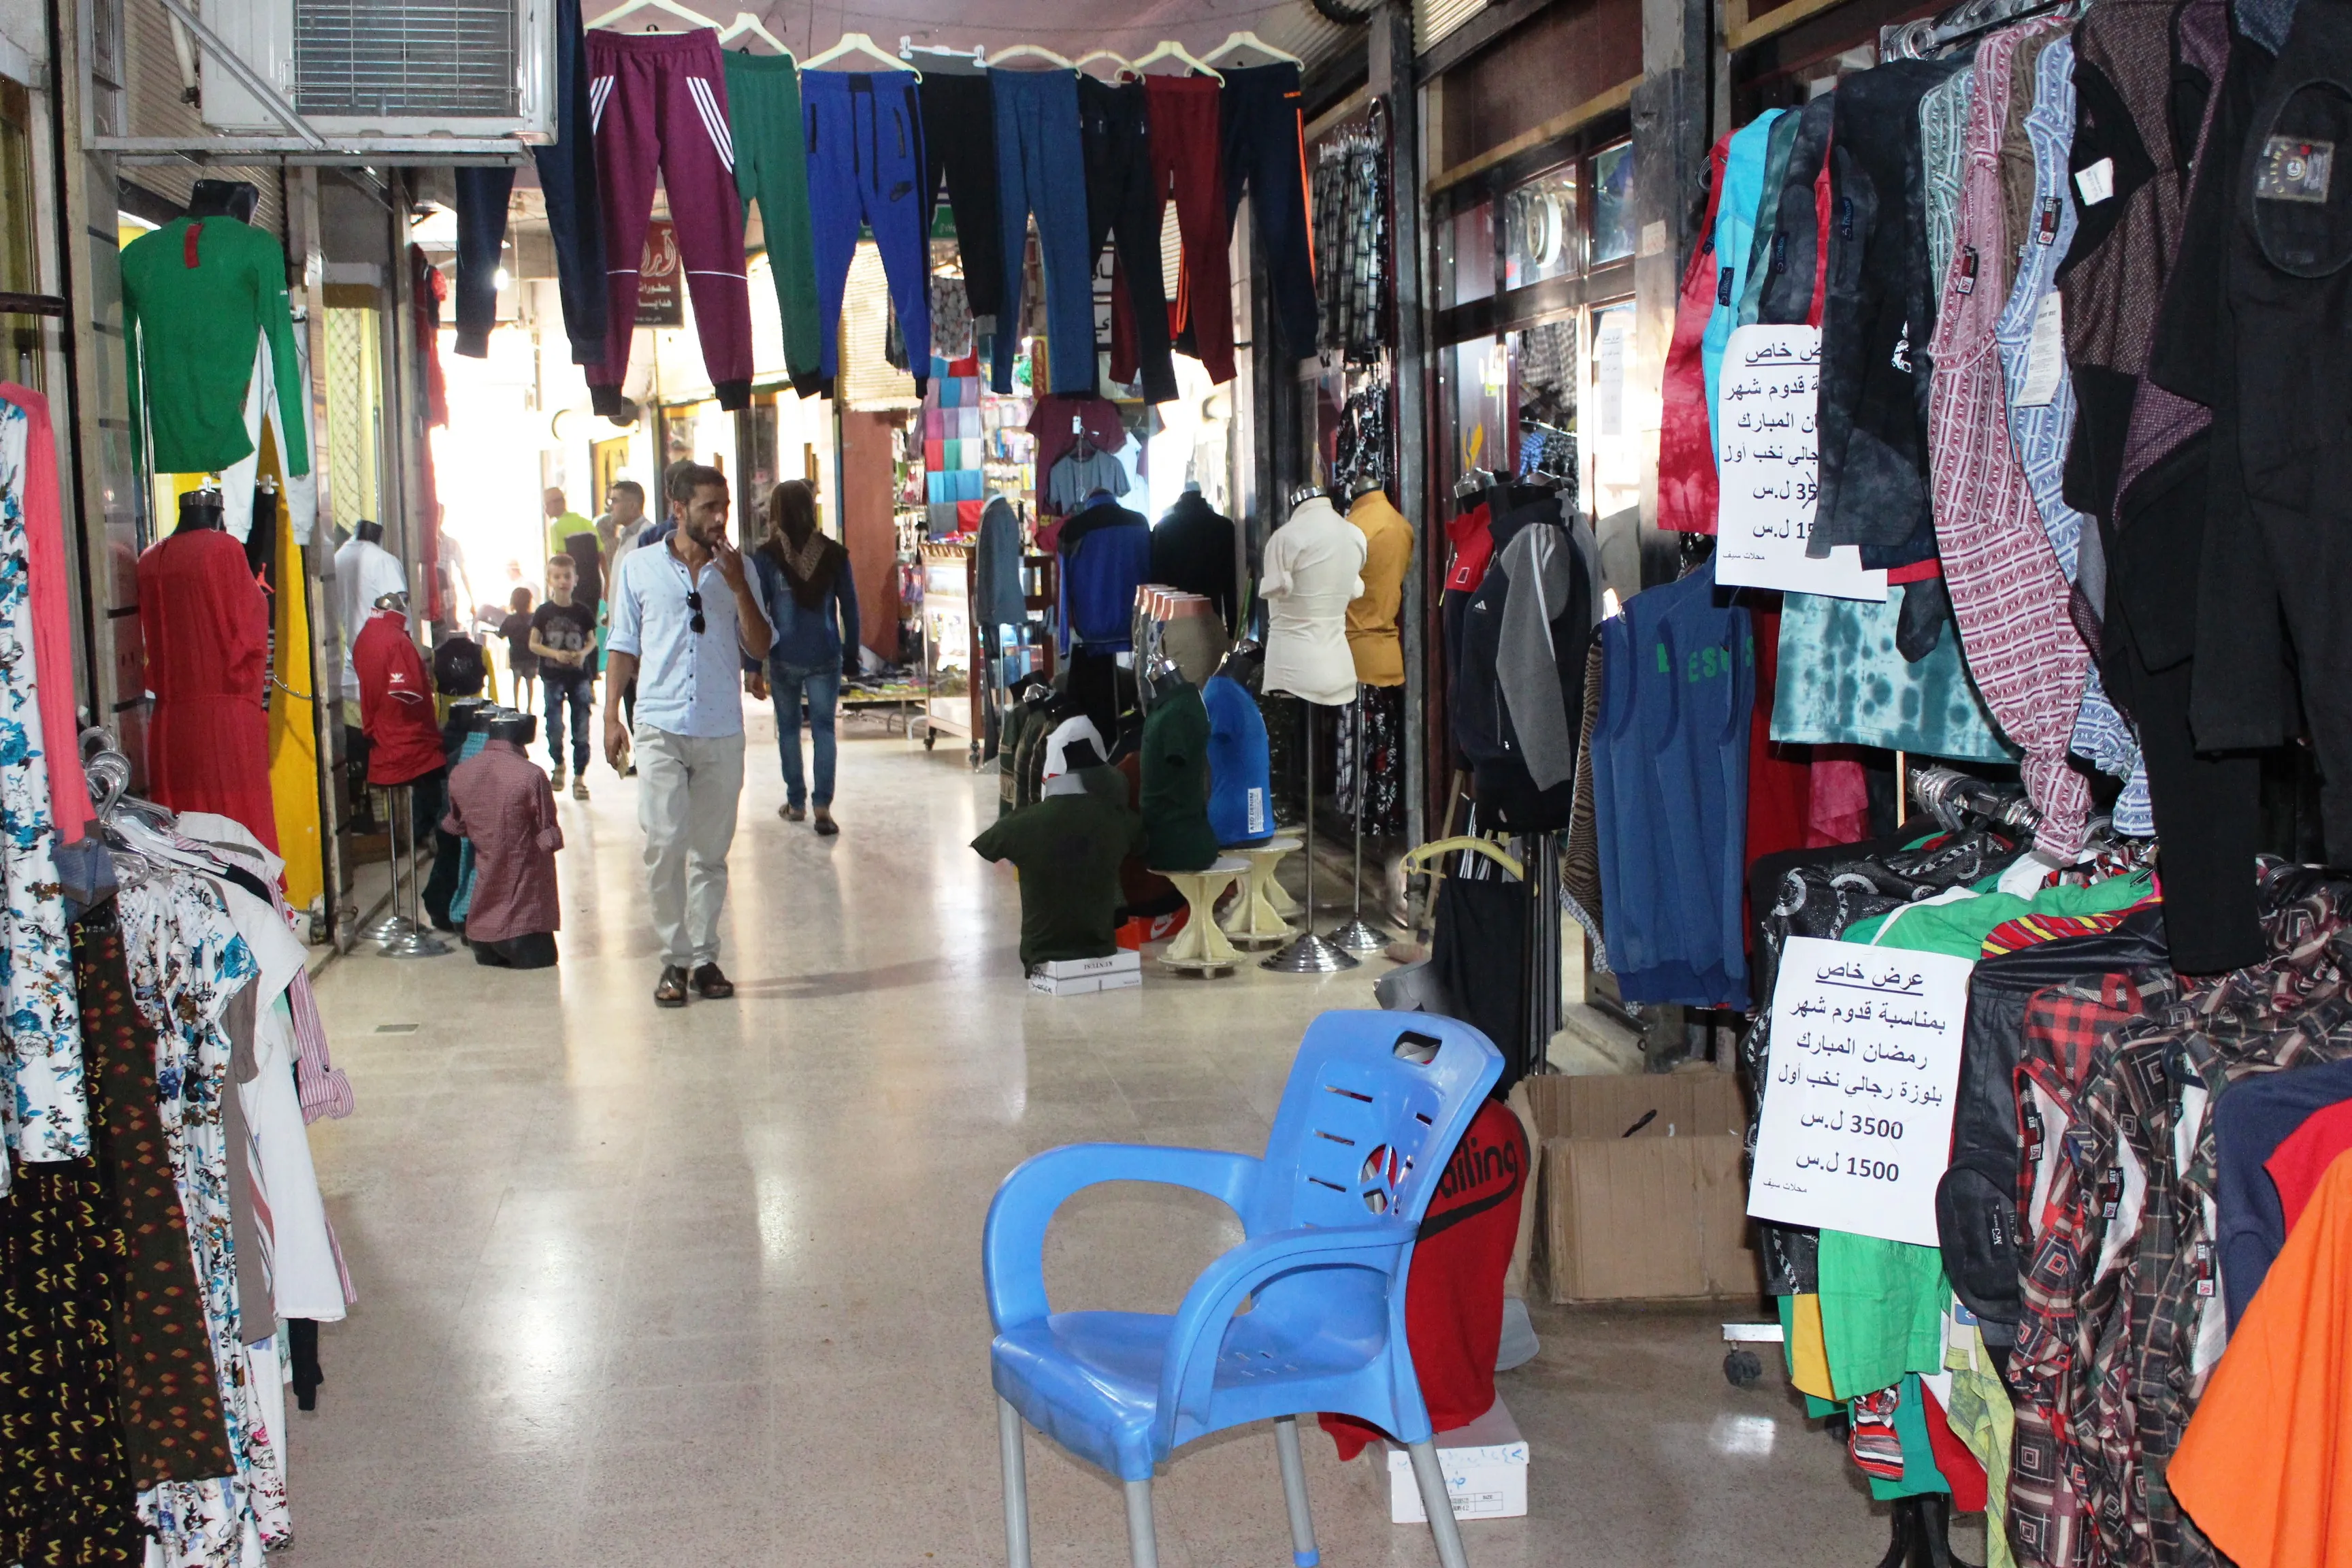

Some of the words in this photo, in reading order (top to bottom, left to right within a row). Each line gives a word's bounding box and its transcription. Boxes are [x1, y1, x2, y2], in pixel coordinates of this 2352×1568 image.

[1745, 342, 1793, 363] خاص
[1725, 378, 1761, 402] شهر
[1769, 376, 1805, 402] قدوم
[1737, 412, 1794, 433] المبارك
[1724, 442, 1746, 463] أول
[1752, 445, 1783, 460] نخب
[1787, 445, 1818, 468] جالي
[1795, 483, 1818, 502] 35
[1743, 551, 1765, 561] محلات
[1816, 961, 1865, 981] خاص
[1871, 966, 1924, 990] عرض
[1790, 996, 1826, 1017] شهر
[1832, 1000, 1872, 1023] قدوم
[1878, 1002, 1946, 1034] بمناسبة
[1796, 1032, 1855, 1056] المبارك
[1863, 1043, 1927, 1069] رمضان
[1778, 1062, 1801, 1083] أول
[1806, 1070, 1840, 1088] نخب
[1844, 1075, 1893, 1098] رجالي
[1899, 1081, 1942, 1107] بلوزة
[1849, 1115, 1904, 1140] 3500
[1846, 1156, 1899, 1182] 1500
[1763, 1177, 1780, 1190] سيف
[1783, 1181, 1808, 1194] محلات
